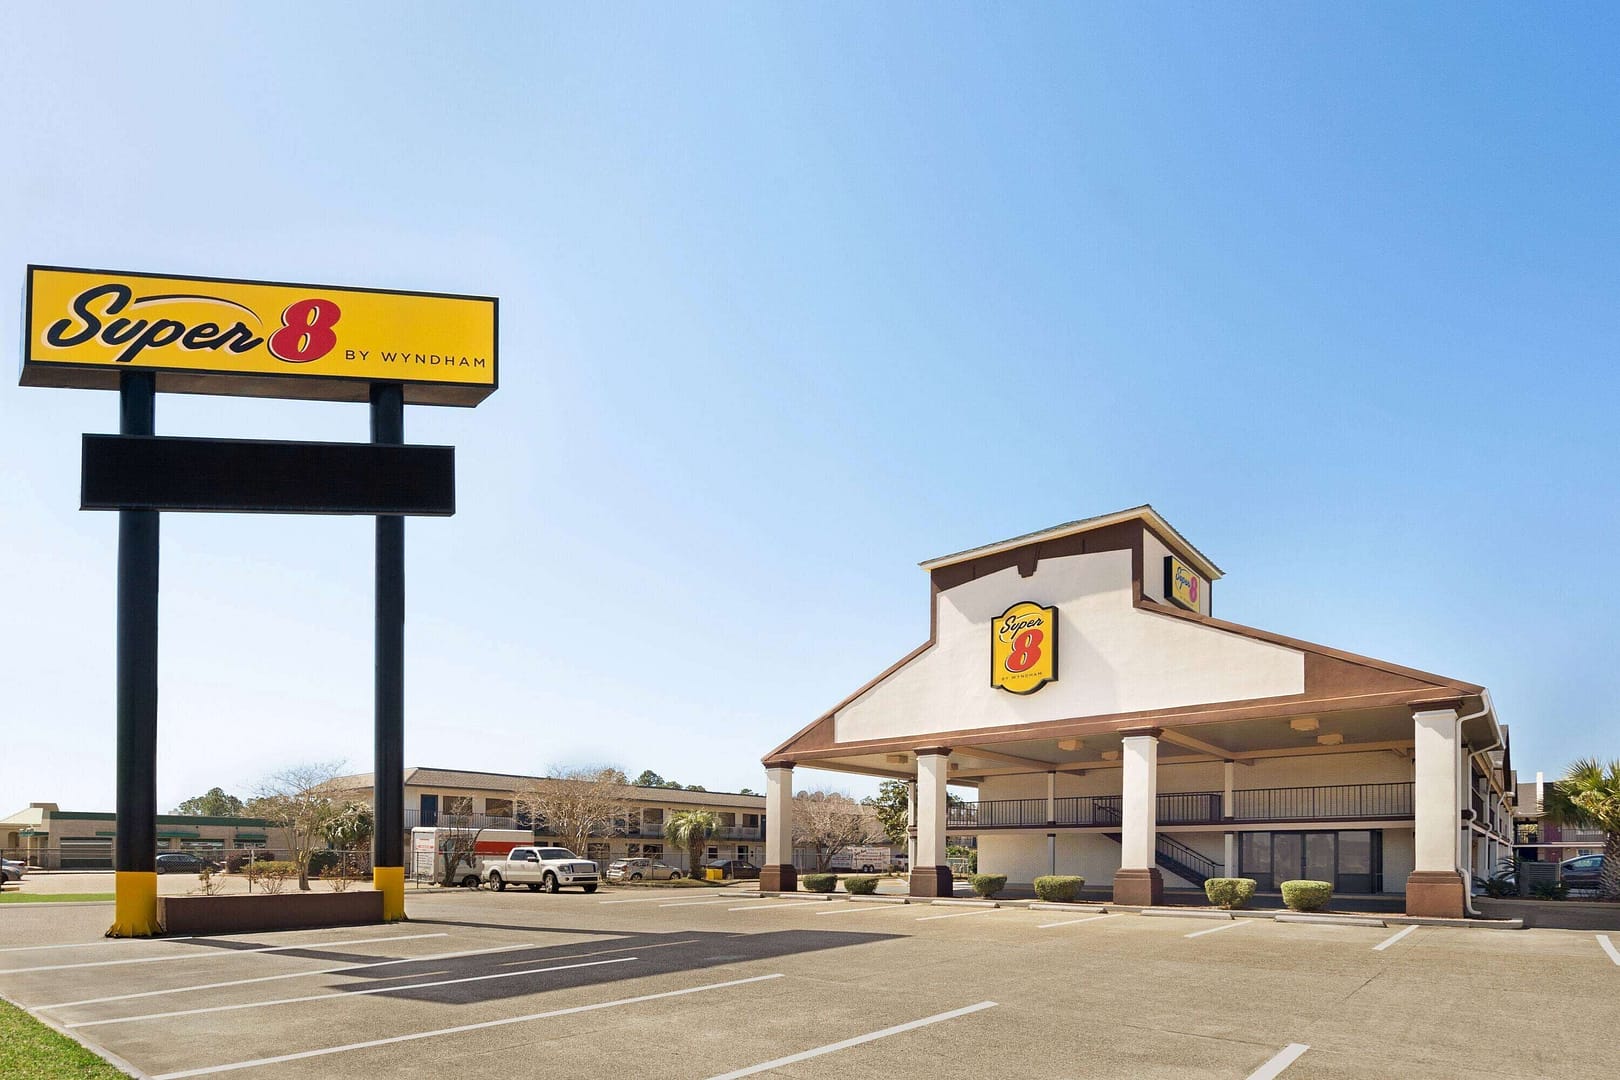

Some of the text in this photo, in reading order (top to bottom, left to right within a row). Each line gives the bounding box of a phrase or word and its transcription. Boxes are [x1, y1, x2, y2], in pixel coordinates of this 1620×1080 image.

[46, 283, 487, 368] Super 8 BY WYNDHAM
[1000, 614, 1044, 640] Super
[1005, 629, 1044, 673] 8
